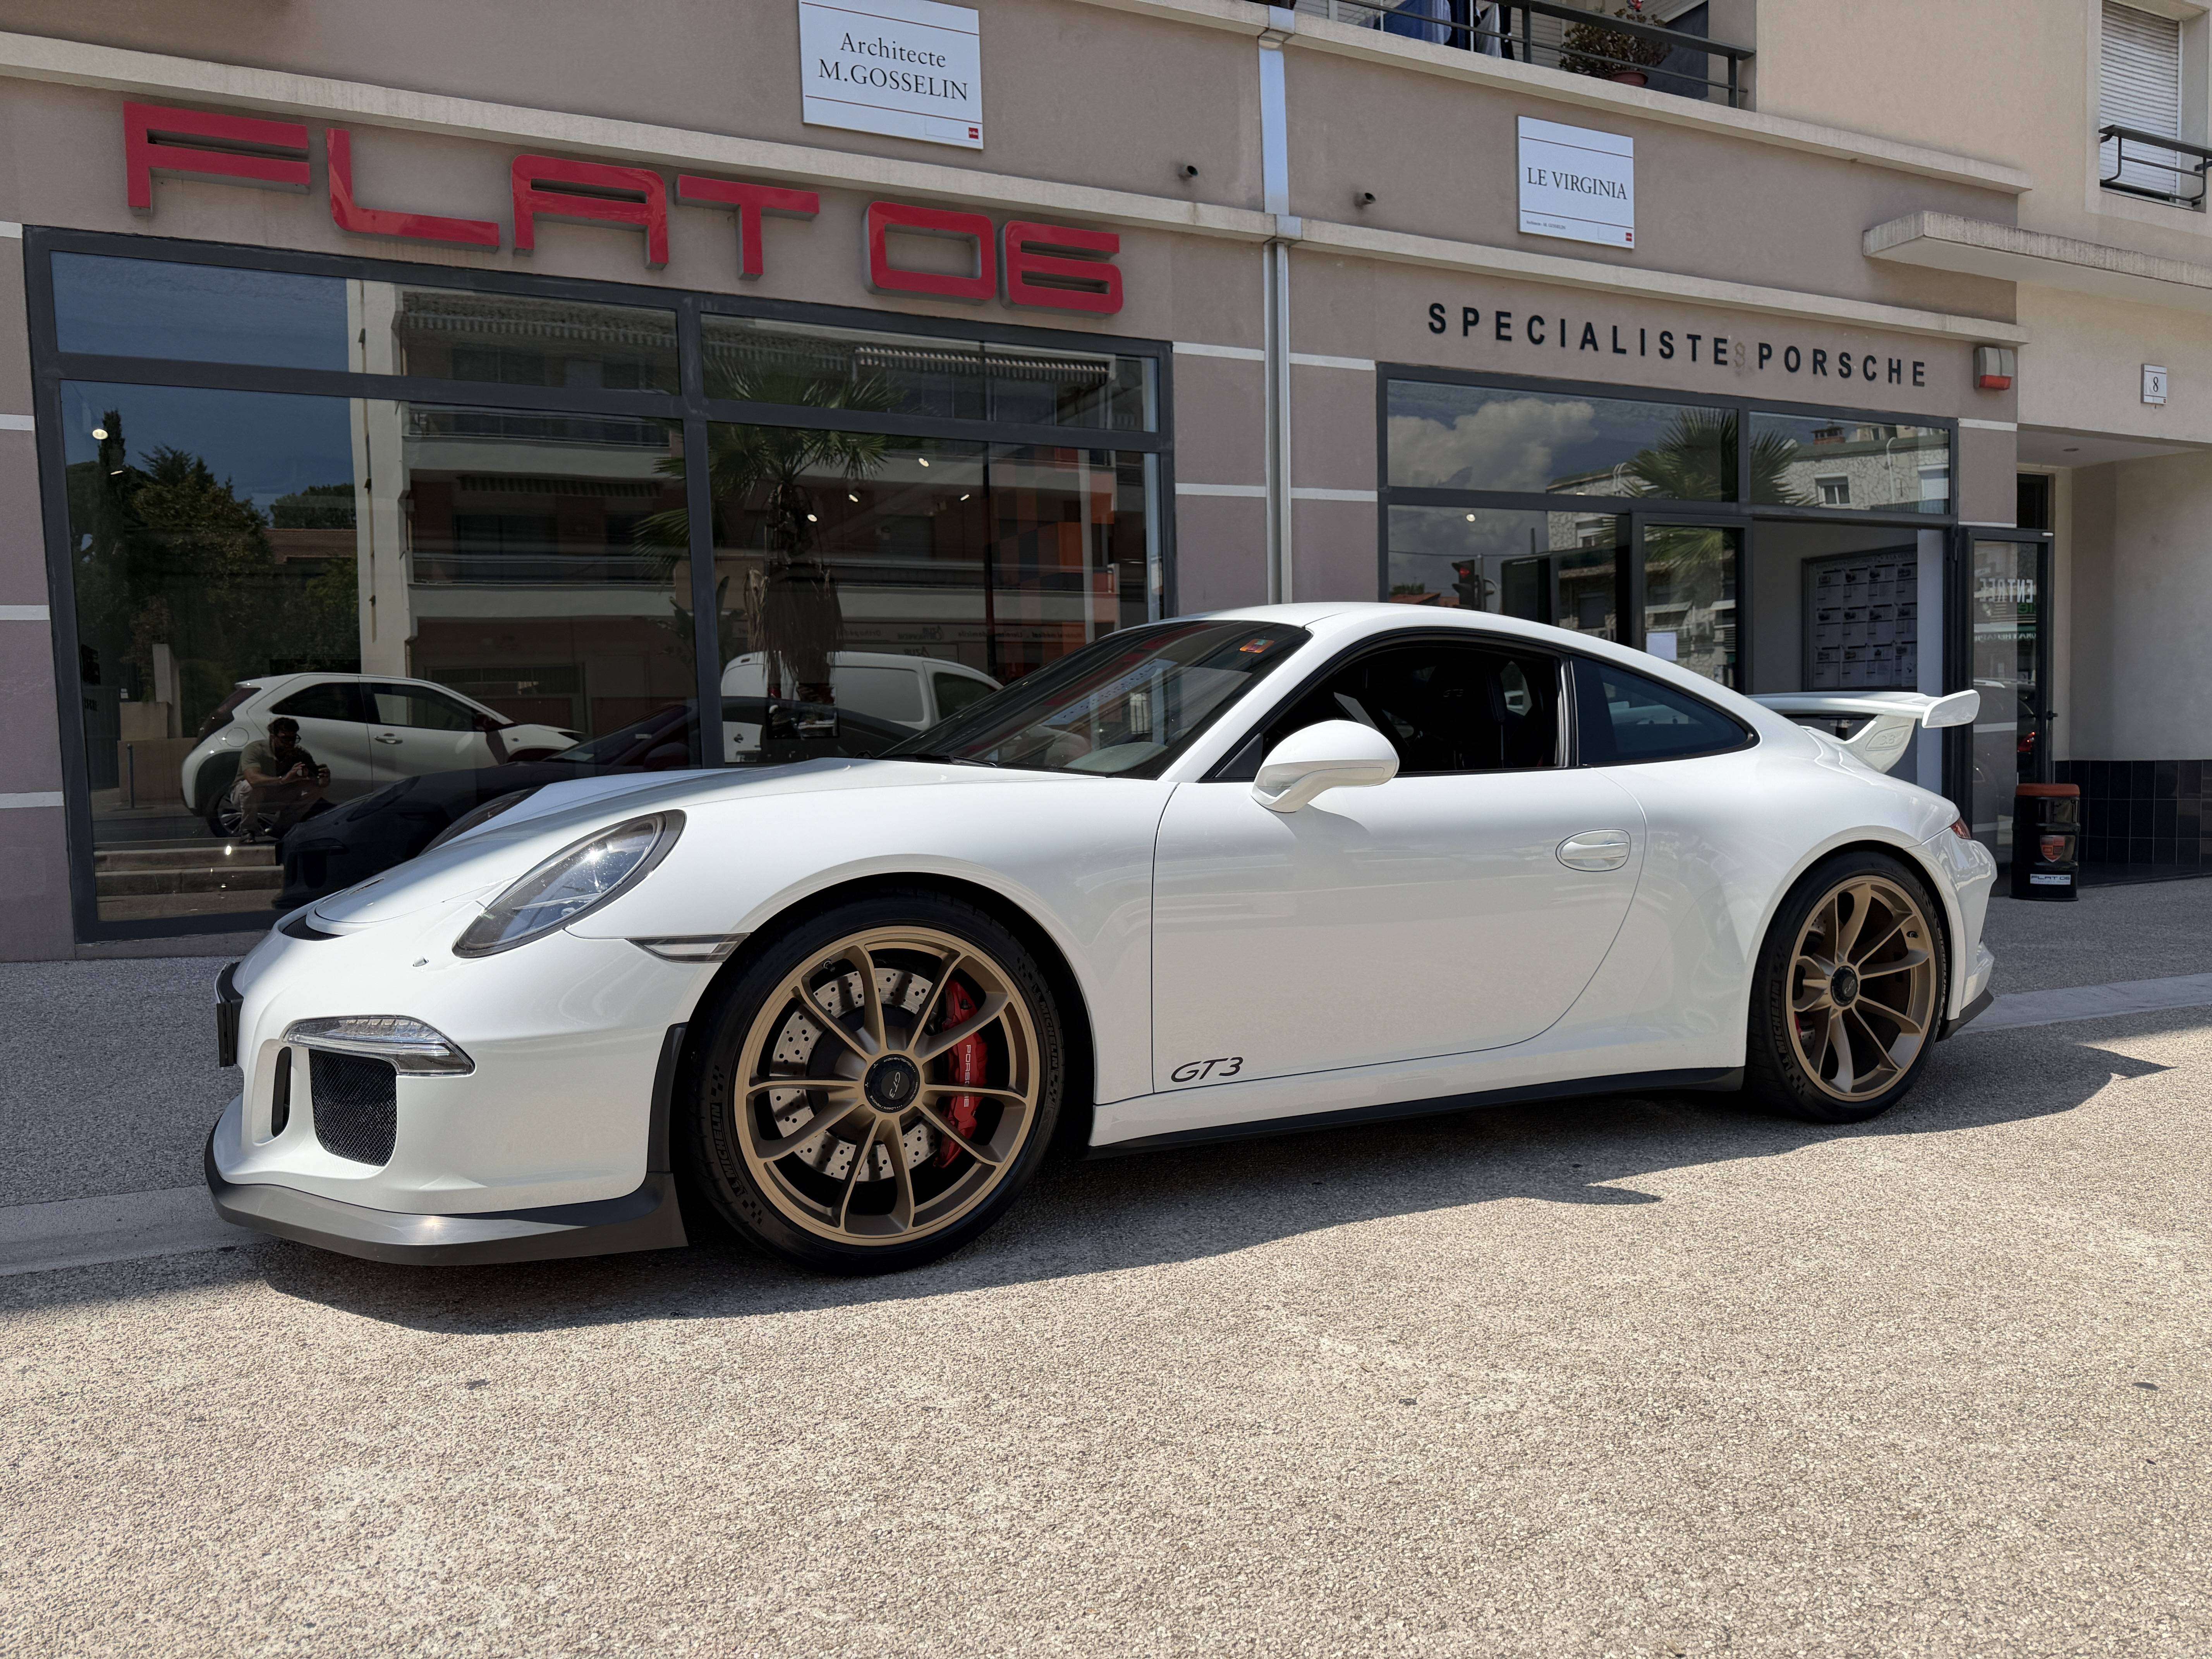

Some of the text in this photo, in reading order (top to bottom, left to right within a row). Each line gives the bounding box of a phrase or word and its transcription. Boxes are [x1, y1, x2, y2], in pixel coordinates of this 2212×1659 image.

[840, 33, 946, 68] Architecte
[818, 58, 968, 101] M.GOSSELIN
[1527, 167, 1628, 200] LE VIRGINIA
[123, 101, 1123, 315] FLAT 06
[1428, 302, 1925, 387] SPECIALISTE PORSCHE
[2153, 376, 2159, 393] 8
[1039, 1001, 1059, 1068] MICHELIN
[1770, 981, 1787, 1054] MICHELIN
[889, 1071, 901, 1098] GT3
[1171, 1056, 1243, 1082] GT3
[711, 1103, 736, 1178] MICHELIN
